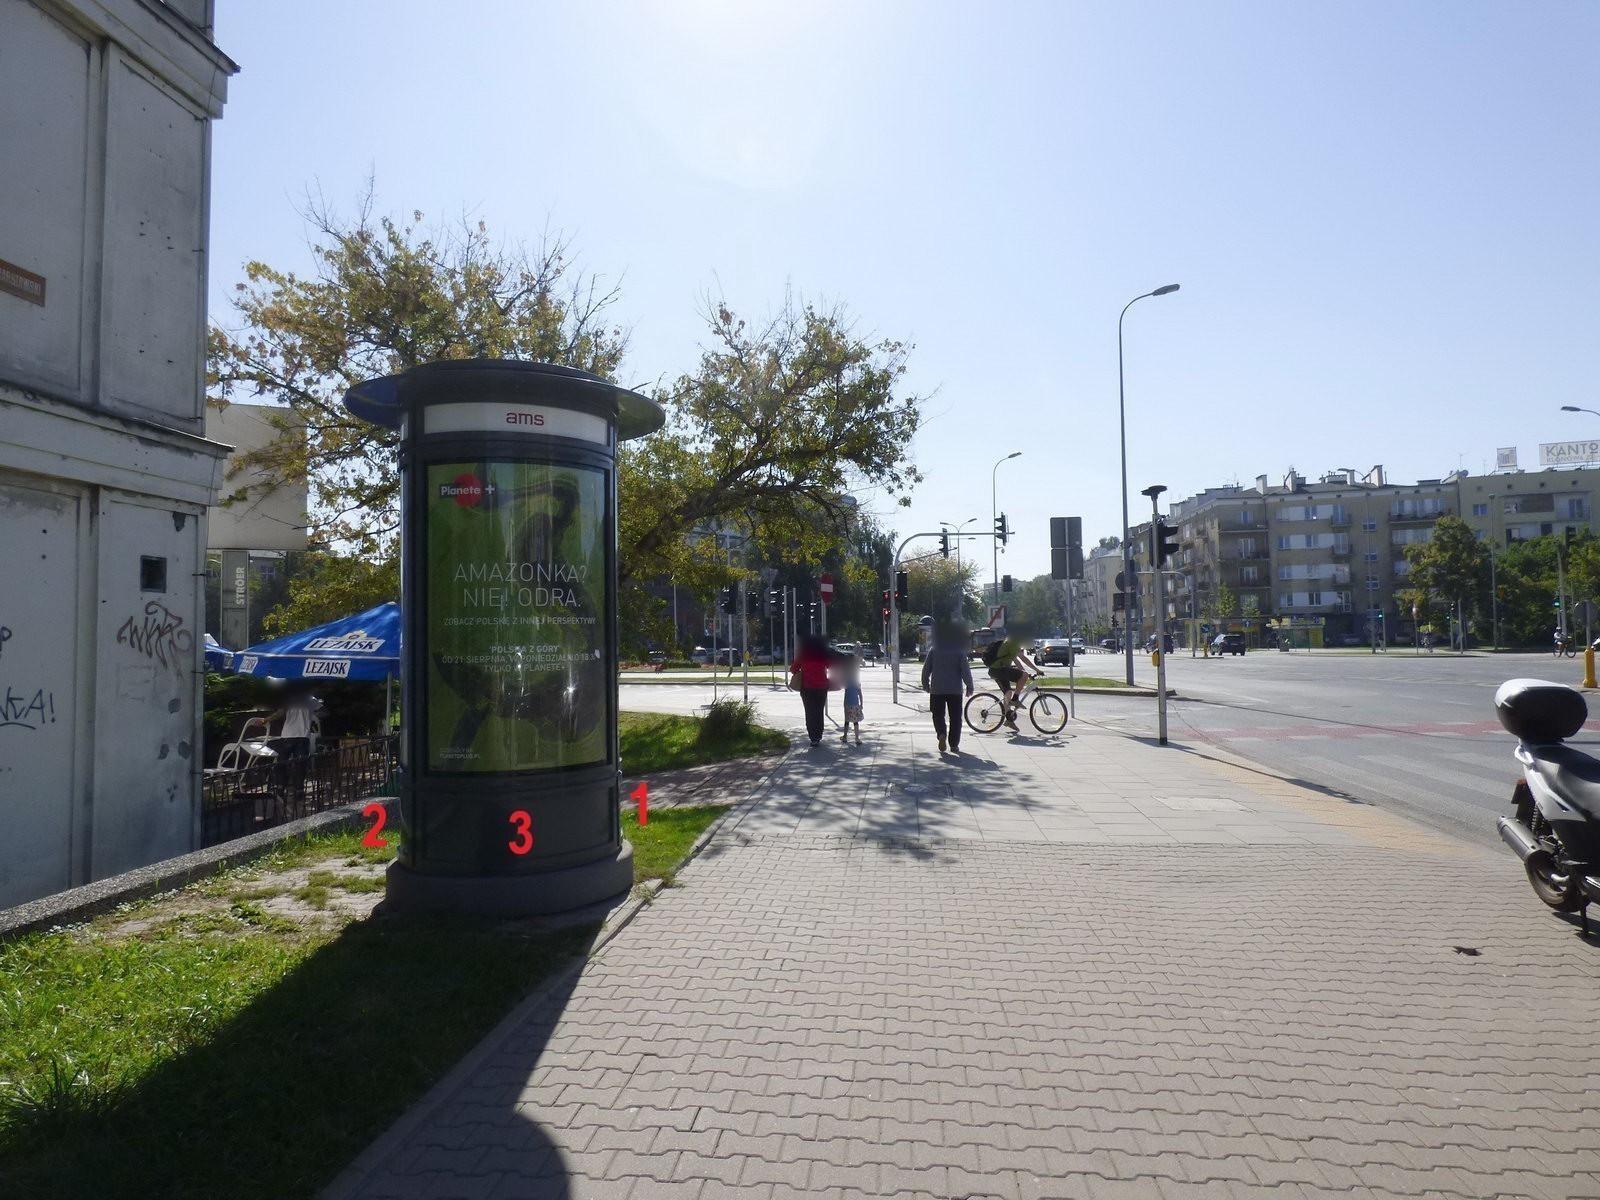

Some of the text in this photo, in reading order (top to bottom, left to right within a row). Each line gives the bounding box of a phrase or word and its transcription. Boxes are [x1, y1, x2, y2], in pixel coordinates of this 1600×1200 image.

[506, 412, 545, 426] ams
[441, 485, 481, 495] Planete
[454, 562, 587, 584] AMAZONKA?
[463, 588, 582, 607] NIE! ODRA.
[444, 617, 474, 625] ZOBACZ
